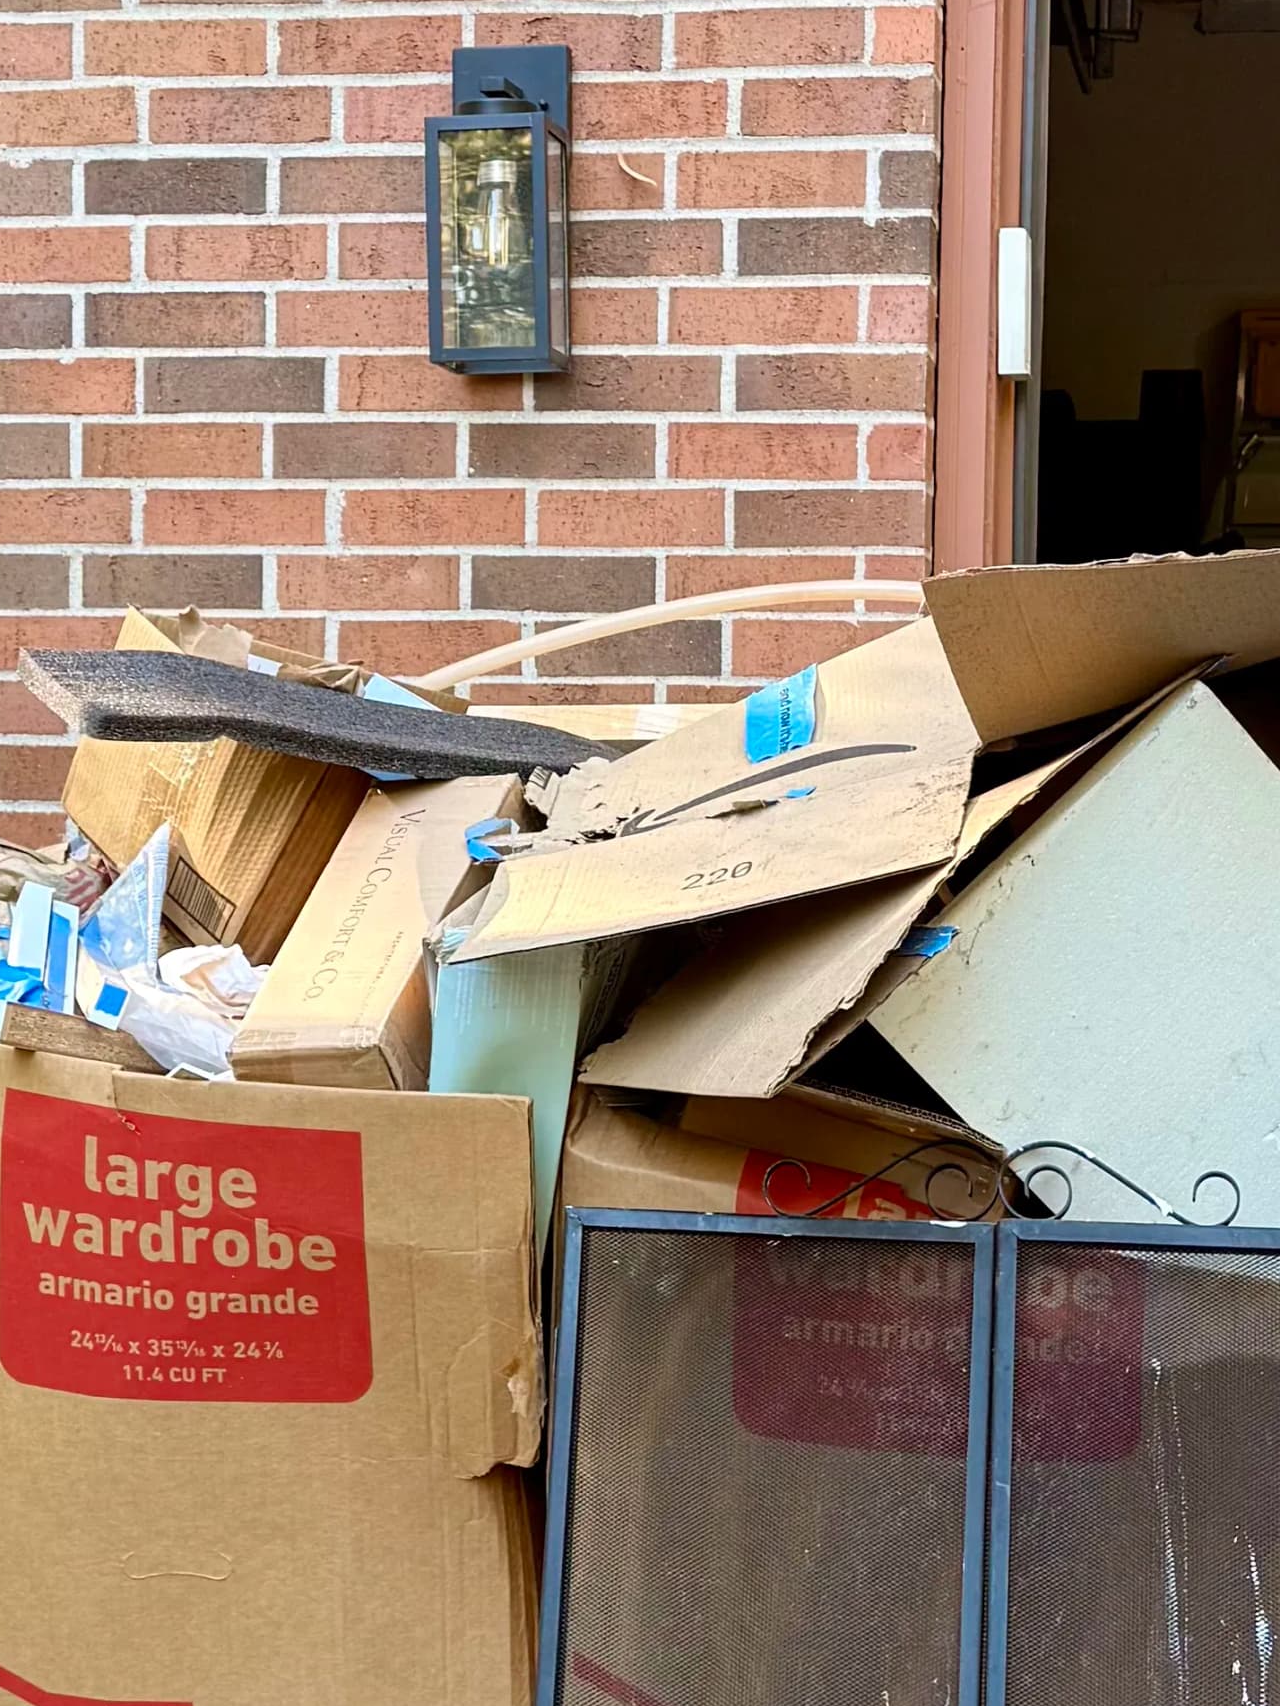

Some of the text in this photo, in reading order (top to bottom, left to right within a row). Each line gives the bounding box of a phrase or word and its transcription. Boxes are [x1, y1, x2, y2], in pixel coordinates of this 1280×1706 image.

[680, 861, 753, 891] 220
[85, 1135, 257, 1218] large
[22, 1201, 337, 1271] wardrobe
[39, 1272, 319, 1320] armario grande
[123, 1365, 227, 1384] 11.4 CU FT
